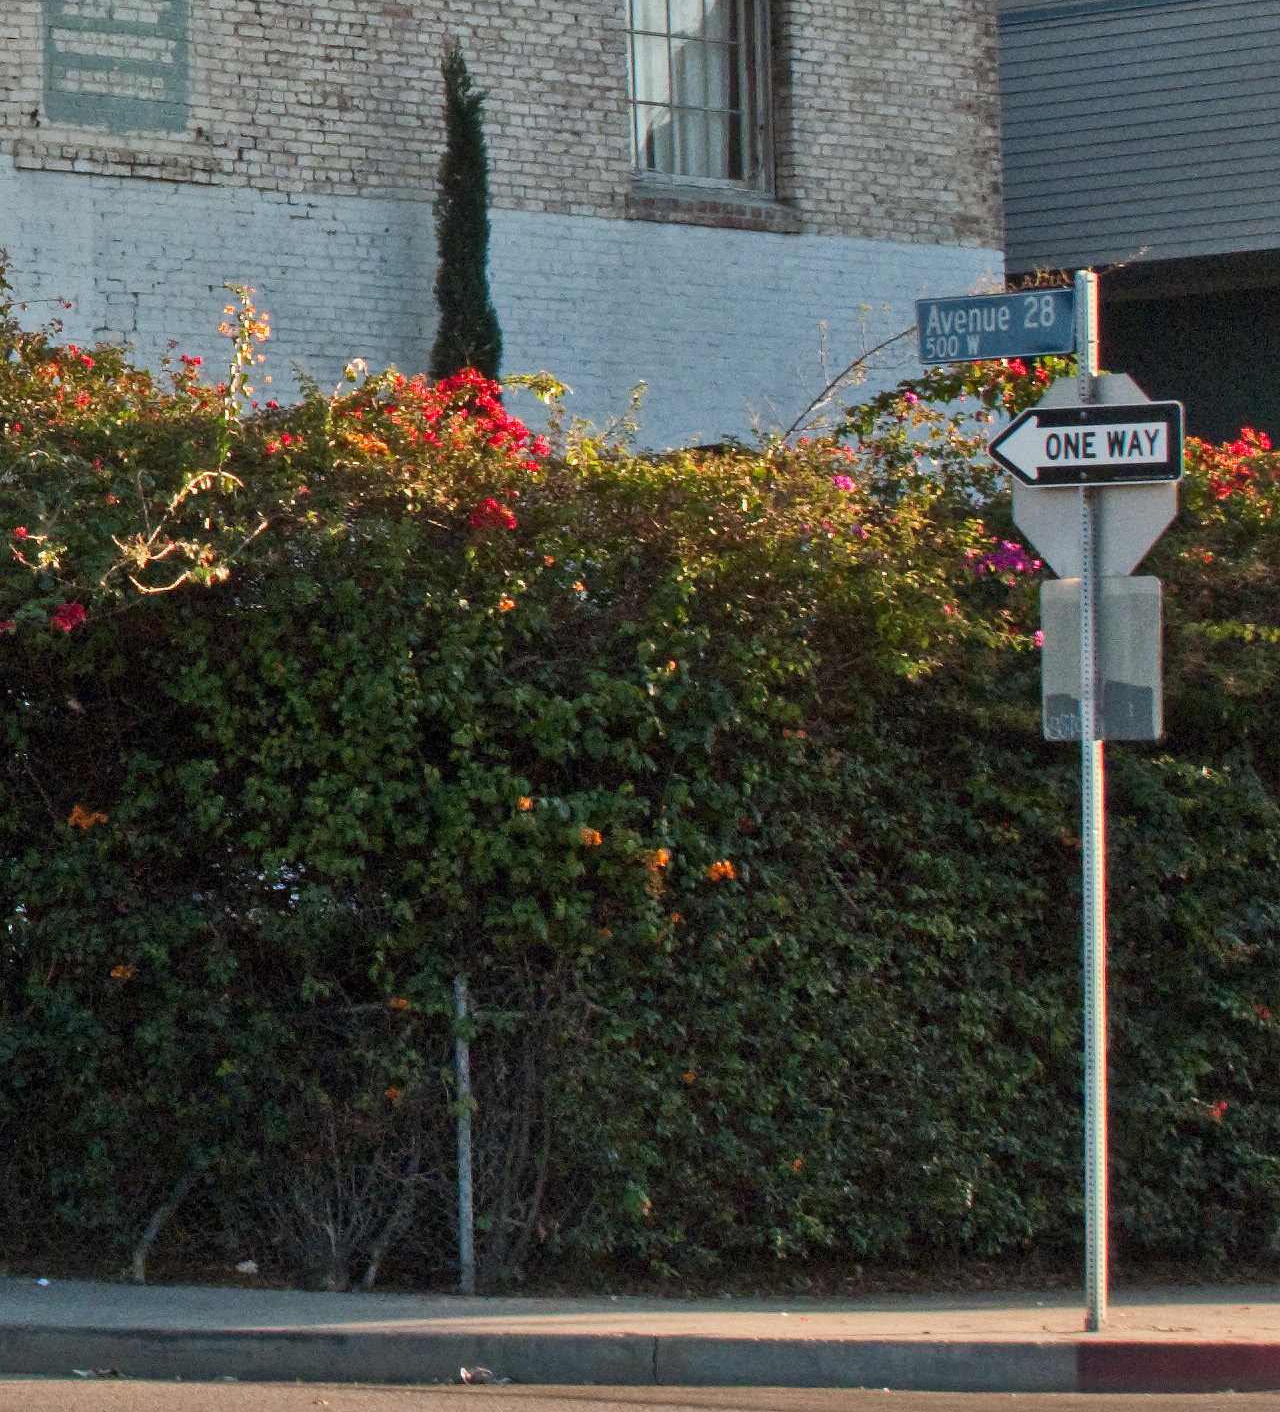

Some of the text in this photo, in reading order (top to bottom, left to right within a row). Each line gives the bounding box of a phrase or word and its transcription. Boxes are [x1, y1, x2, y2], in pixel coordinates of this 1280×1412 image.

[926, 295, 1055, 336] Avenue 28
[926, 334, 980, 359] 500 W
[1045, 428, 1159, 460] ONE WAY
